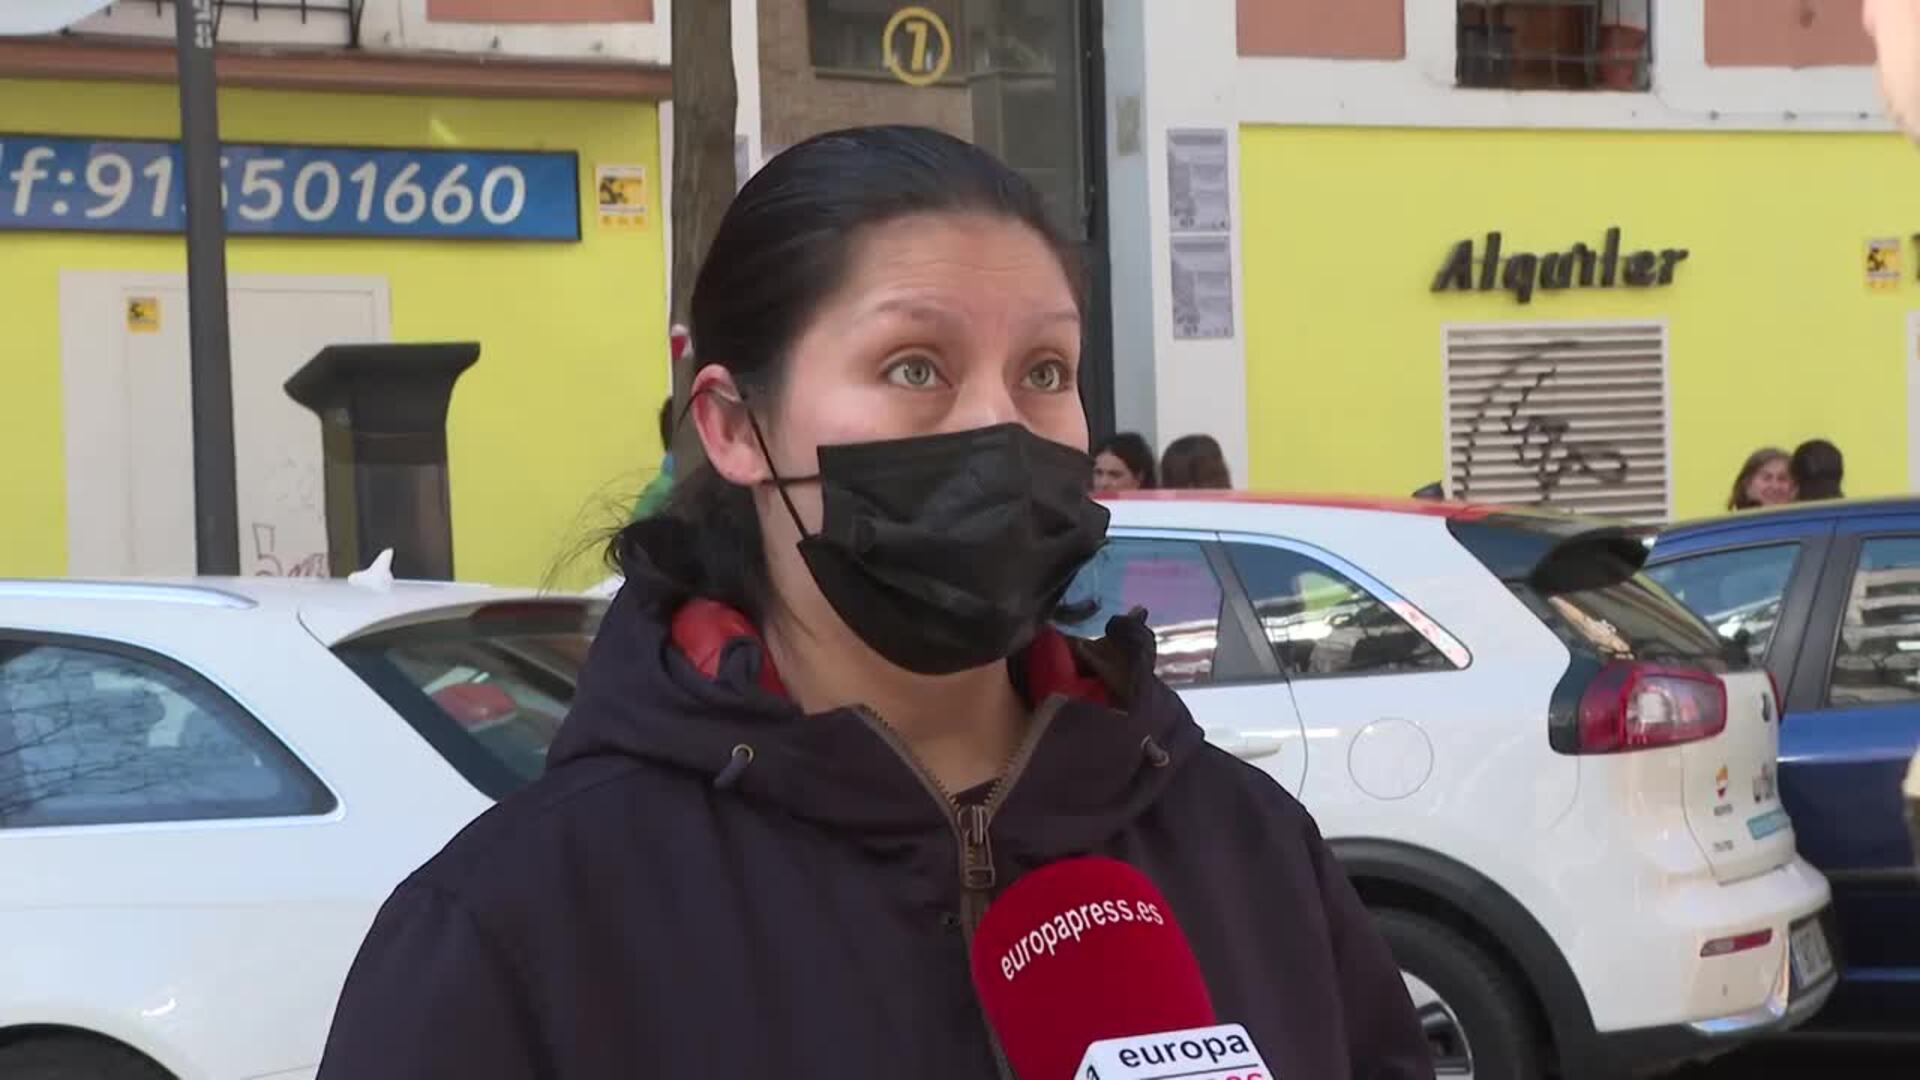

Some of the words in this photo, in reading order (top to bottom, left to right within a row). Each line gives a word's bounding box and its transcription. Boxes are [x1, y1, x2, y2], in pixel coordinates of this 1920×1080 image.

[0, 143, 526, 225] f:91501660
[1430, 226, 1690, 304] Alquiler
[1001, 899, 1164, 981] europapress.es
[1118, 1034, 1250, 1068] europa
